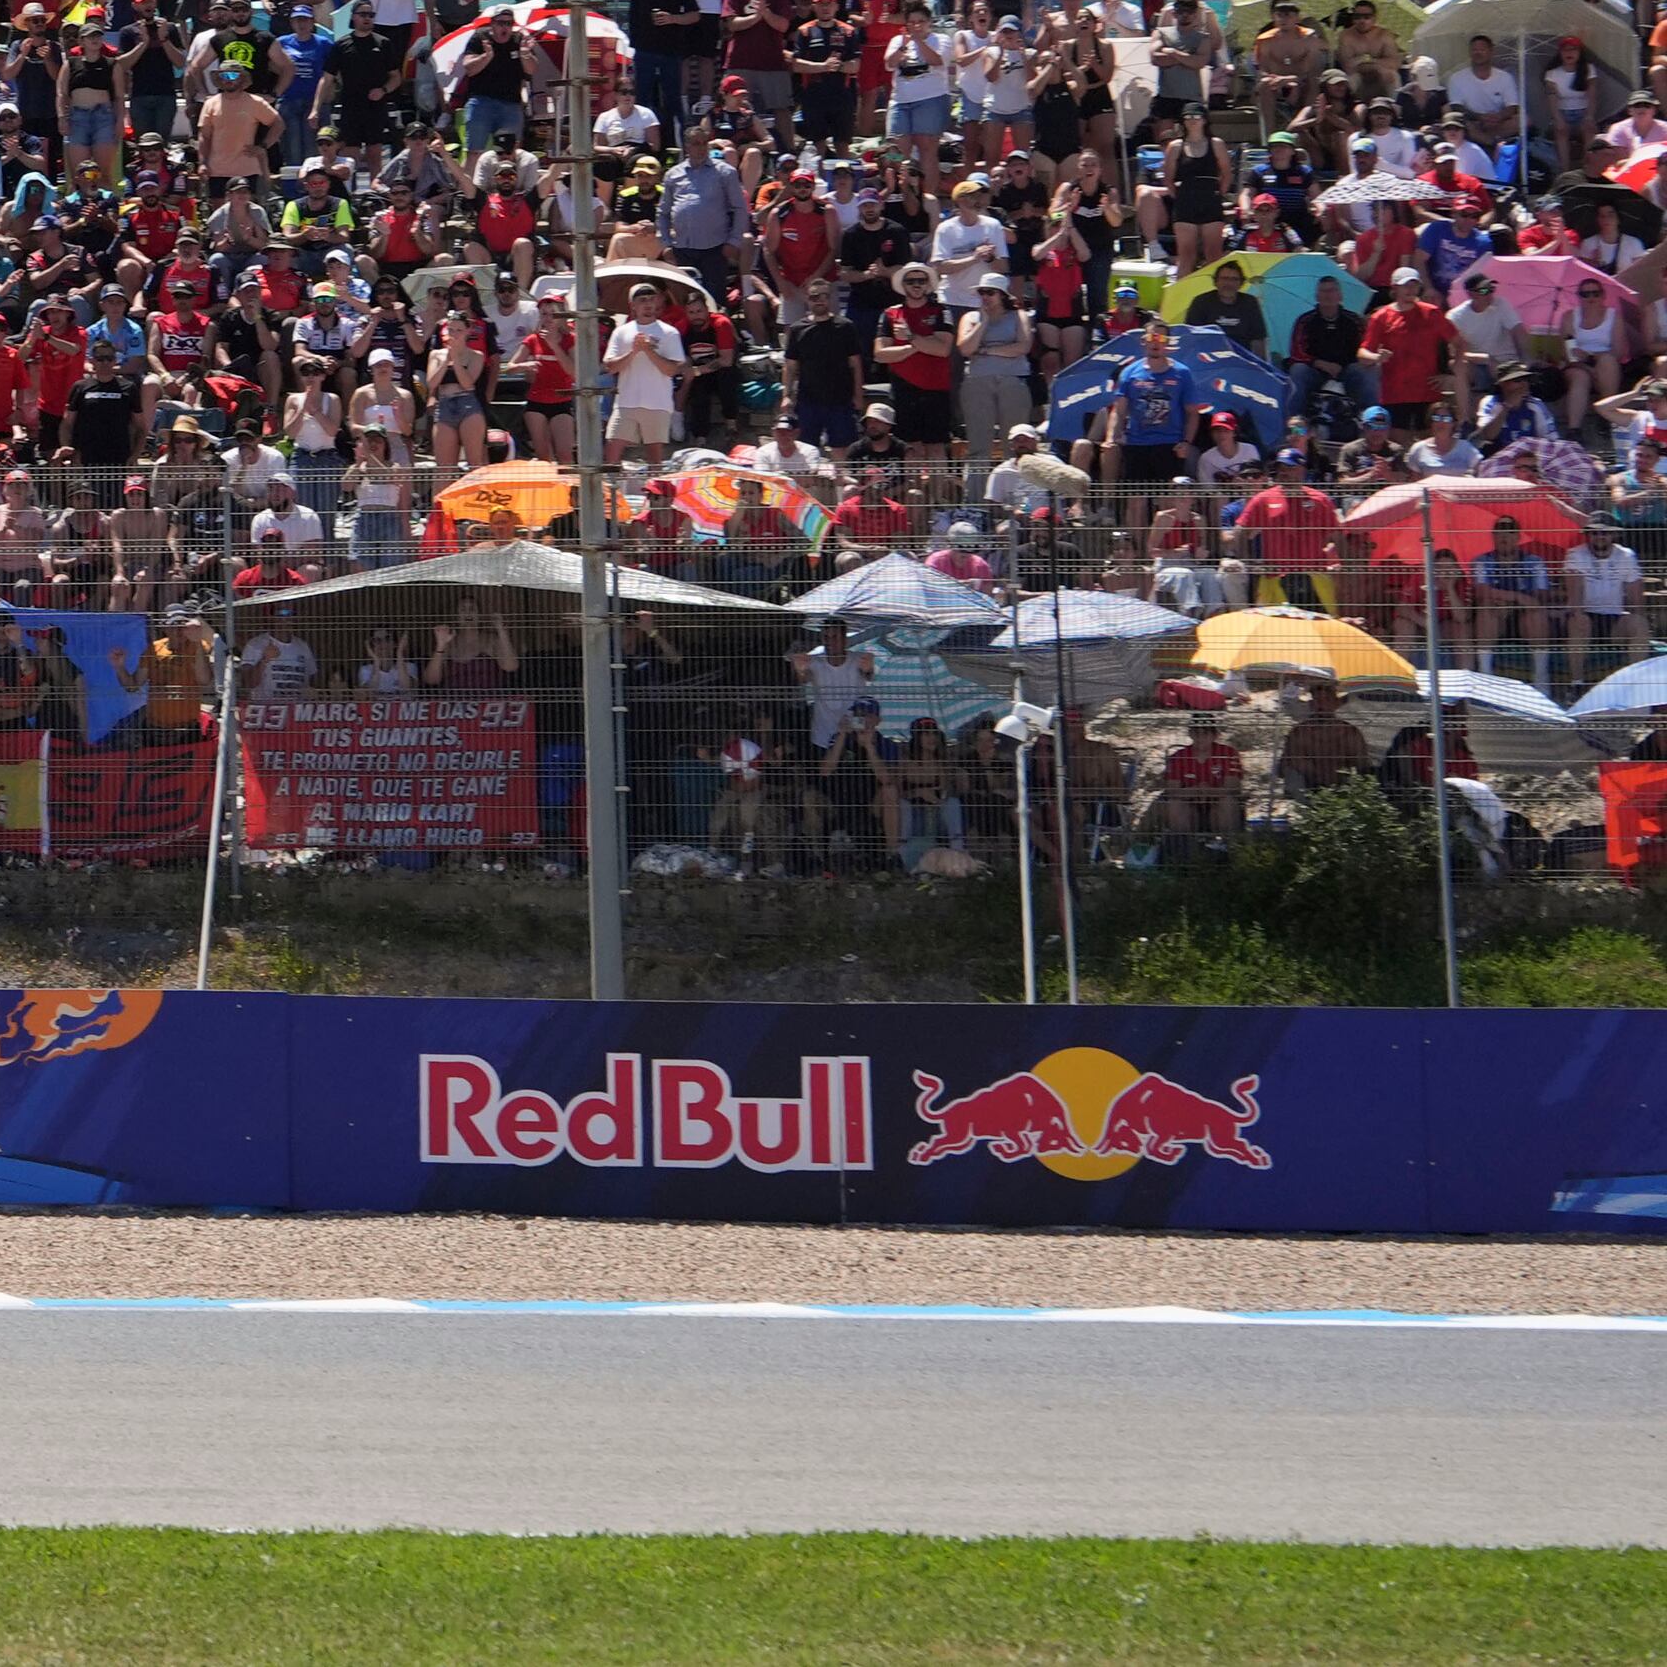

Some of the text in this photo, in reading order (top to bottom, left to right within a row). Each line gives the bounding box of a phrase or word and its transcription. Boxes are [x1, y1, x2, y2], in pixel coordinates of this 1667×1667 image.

[242, 703, 289, 730] 93
[294, 700, 480, 726] MARC, SI ME DAS
[480, 700, 529, 729] 93
[312, 725, 464, 749] TUS GUANTES,
[261, 749, 522, 772] TE PROMETO NO DECIRLE
[275, 772, 509, 799] A NADIE, QUE TE GANÉ
[310, 802, 478, 823] AL MARIO KART
[275, 833, 299, 845] 93
[305, 827, 484, 846] ME LLAMO HUGO
[510, 832, 536, 845] 93
[420, 1052, 873, 1173] Red Bull
